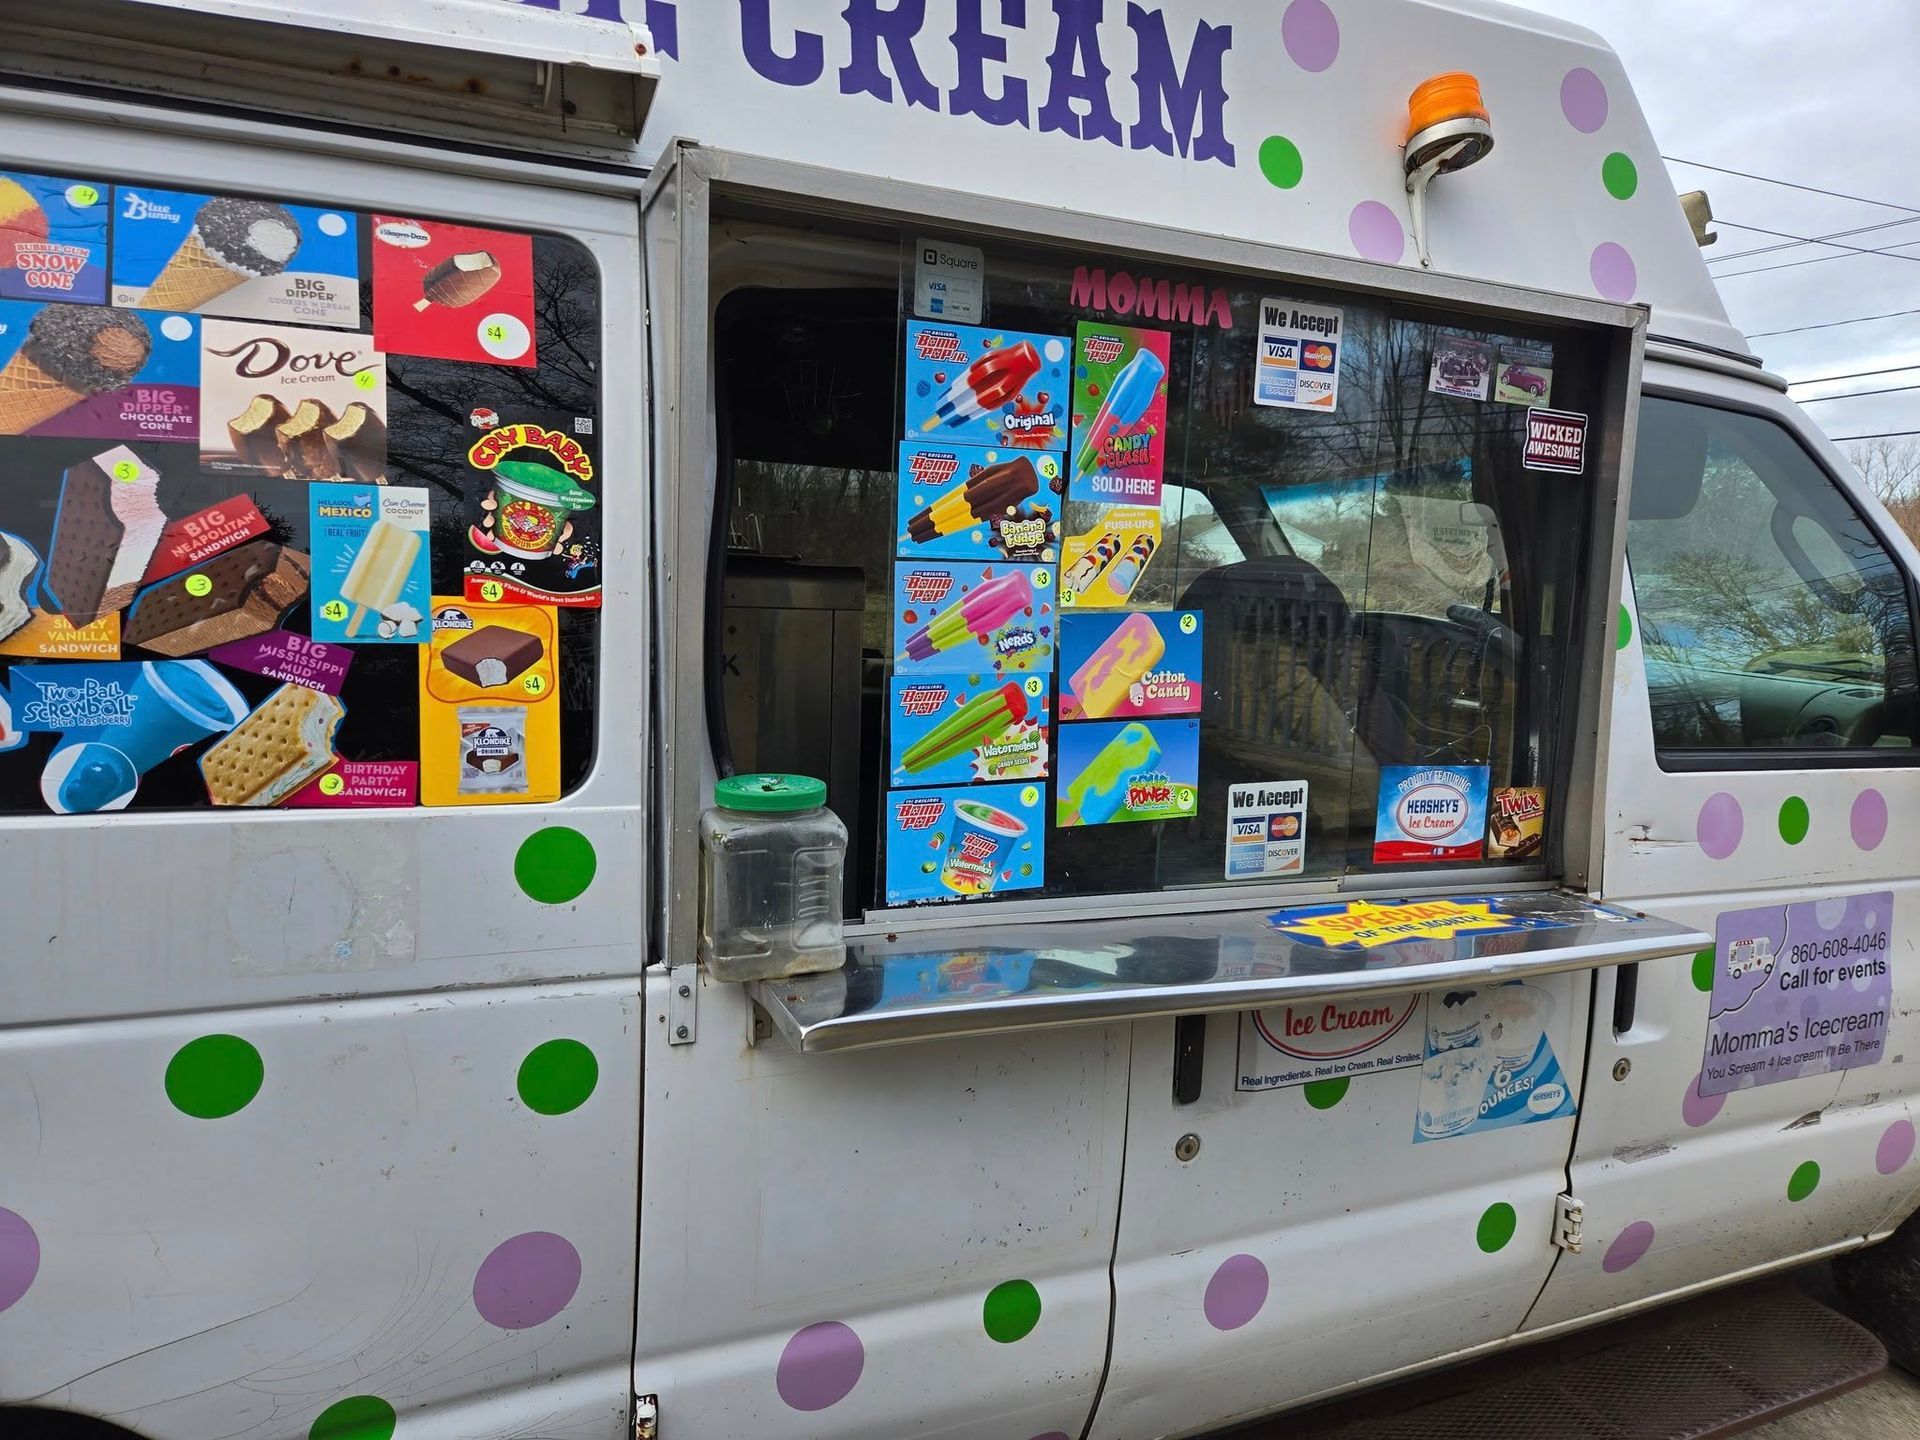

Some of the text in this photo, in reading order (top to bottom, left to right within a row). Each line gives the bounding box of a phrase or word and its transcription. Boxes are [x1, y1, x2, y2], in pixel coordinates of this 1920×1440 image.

[740, 0, 1236, 168] CREAM
[62, 246, 91, 258] GUM
[16, 252, 87, 273] SNOW
[940, 253, 978, 270] Square
[25, 270, 75, 290] CONE
[295, 278, 326, 292] BIG
[928, 281, 948, 292] VISA
[286, 289, 335, 302] DIPPER
[1070, 265, 1234, 330] MOMMA
[293, 306, 328, 317] CONE
[1264, 306, 1339, 337] We Accept
[915, 334, 960, 349] BOMB
[1085, 338, 1124, 353] BOMB
[919, 348, 951, 361] POP
[1087, 351, 1118, 363] POP
[1268, 345, 1293, 358] VISA
[280, 374, 336, 385] Ice Cream
[1260, 375, 1296, 387] AMERICAN
[1299, 379, 1332, 390] DISCOVER
[137, 389, 177, 405] BIG
[1266, 386, 1296, 396] EXPRESS
[123, 402, 183, 415] DIPPER
[119, 412, 193, 424] CHOCOLATE
[1004, 413, 1055, 431] Original
[139, 421, 173, 431] CONE
[1530, 421, 1583, 444] WICKED
[1104, 433, 1151, 452] CANDY
[469, 424, 594, 480] CRY BABY
[1527, 441, 1580, 460] AWESOME
[910, 456, 959, 472] BOMB
[1105, 449, 1150, 470] CLASH
[119, 463, 132, 479] 3
[1044, 463, 1055, 476] $3
[913, 471, 953, 485] POP
[1092, 475, 1156, 495] SOLD HERE
[319, 505, 373, 519] MEXICO
[183, 510, 226, 538] BIG
[1001, 518, 1046, 535] Banana
[1104, 520, 1155, 530] PUSH-UPS
[170, 512, 256, 558] NEAPOLITAN
[1005, 532, 1045, 547] Fudge
[189, 528, 250, 561] SANDWICH
[194, 577, 207, 592] 3
[906, 576, 954, 590] BOMB
[1037, 572, 1047, 585] $3
[482, 584, 498, 599] $4
[909, 589, 947, 603] POP
[1061, 590, 1072, 603] $3
[325, 602, 342, 618] $4
[432, 619, 474, 632] KLONDIKE
[1182, 616, 1192, 628] $2
[48, 631, 110, 642] VANILLA
[39, 643, 119, 654] SANDWICH
[287, 635, 328, 659] BIG
[258, 643, 344, 676] MISSISSIPPI
[279, 661, 312, 678] MUD
[261, 666, 326, 691] SANDWICH
[524, 676, 541, 691] $4
[1141, 670, 1187, 685] Cotton
[1027, 681, 1038, 693] $3
[1146, 684, 1190, 701] Candy
[901, 690, 949, 703] BOMB
[904, 702, 942, 715] POP
[473, 736, 513, 749] KLONDIKE
[983, 741, 1038, 759] Watermelon
[343, 764, 409, 775] BIRTHDAY
[351, 775, 394, 787] PARTY
[1397, 770, 1472, 793] PROUDLY FEATURING
[1027, 791, 1035, 801] 4
[1129, 786, 1172, 805] POWER
[1180, 790, 1189, 802] $2
[1233, 788, 1304, 808] We Accept
[899, 804, 945, 817] BOMB
[1407, 799, 1459, 814] HERSHEY'S
[902, 816, 937, 830] POP
[1237, 824, 1261, 835] VISA
[1409, 815, 1456, 829] Ice Cream
[963, 834, 999, 852] BOMB
[962, 845, 990, 859] POP
[1268, 848, 1298, 857] DISCOVER
[950, 858, 994, 876] Watermelon
[1317, 904, 1468, 932] SPECIAL
[1354, 913, 1482, 939] OF THE MONTH
[1790, 932, 1887, 965] 860-608-4046
[1779, 958, 1887, 991] Call for events
[1285, 1005, 1394, 1037] Ice Cream
[1710, 1010, 1885, 1057] Momma's Icecream
[1707, 1067, 1726, 1081] You
[1727, 1060, 1766, 1076] Scream
[1768, 1056, 1775, 1067] 4
[1777, 1054, 1792, 1067] Ice
[1793, 1050, 1824, 1064] cream
[1838, 1043, 1851, 1057] Be
[1852, 1038, 1881, 1053] There
[1241, 1076, 1263, 1086] Real
[1264, 1070, 1313, 1086] Ingredients.
[1315, 1066, 1333, 1077] Real
[1334, 1064, 1346, 1074] Ice
[1347, 1062, 1374, 1073] Cream.
[1376, 1056, 1394, 1067] Real
[1493, 1062, 1512, 1090] 6
[1479, 1076, 1536, 1114] OUNCES!
[1532, 1089, 1562, 1102] HERSHEY'S
